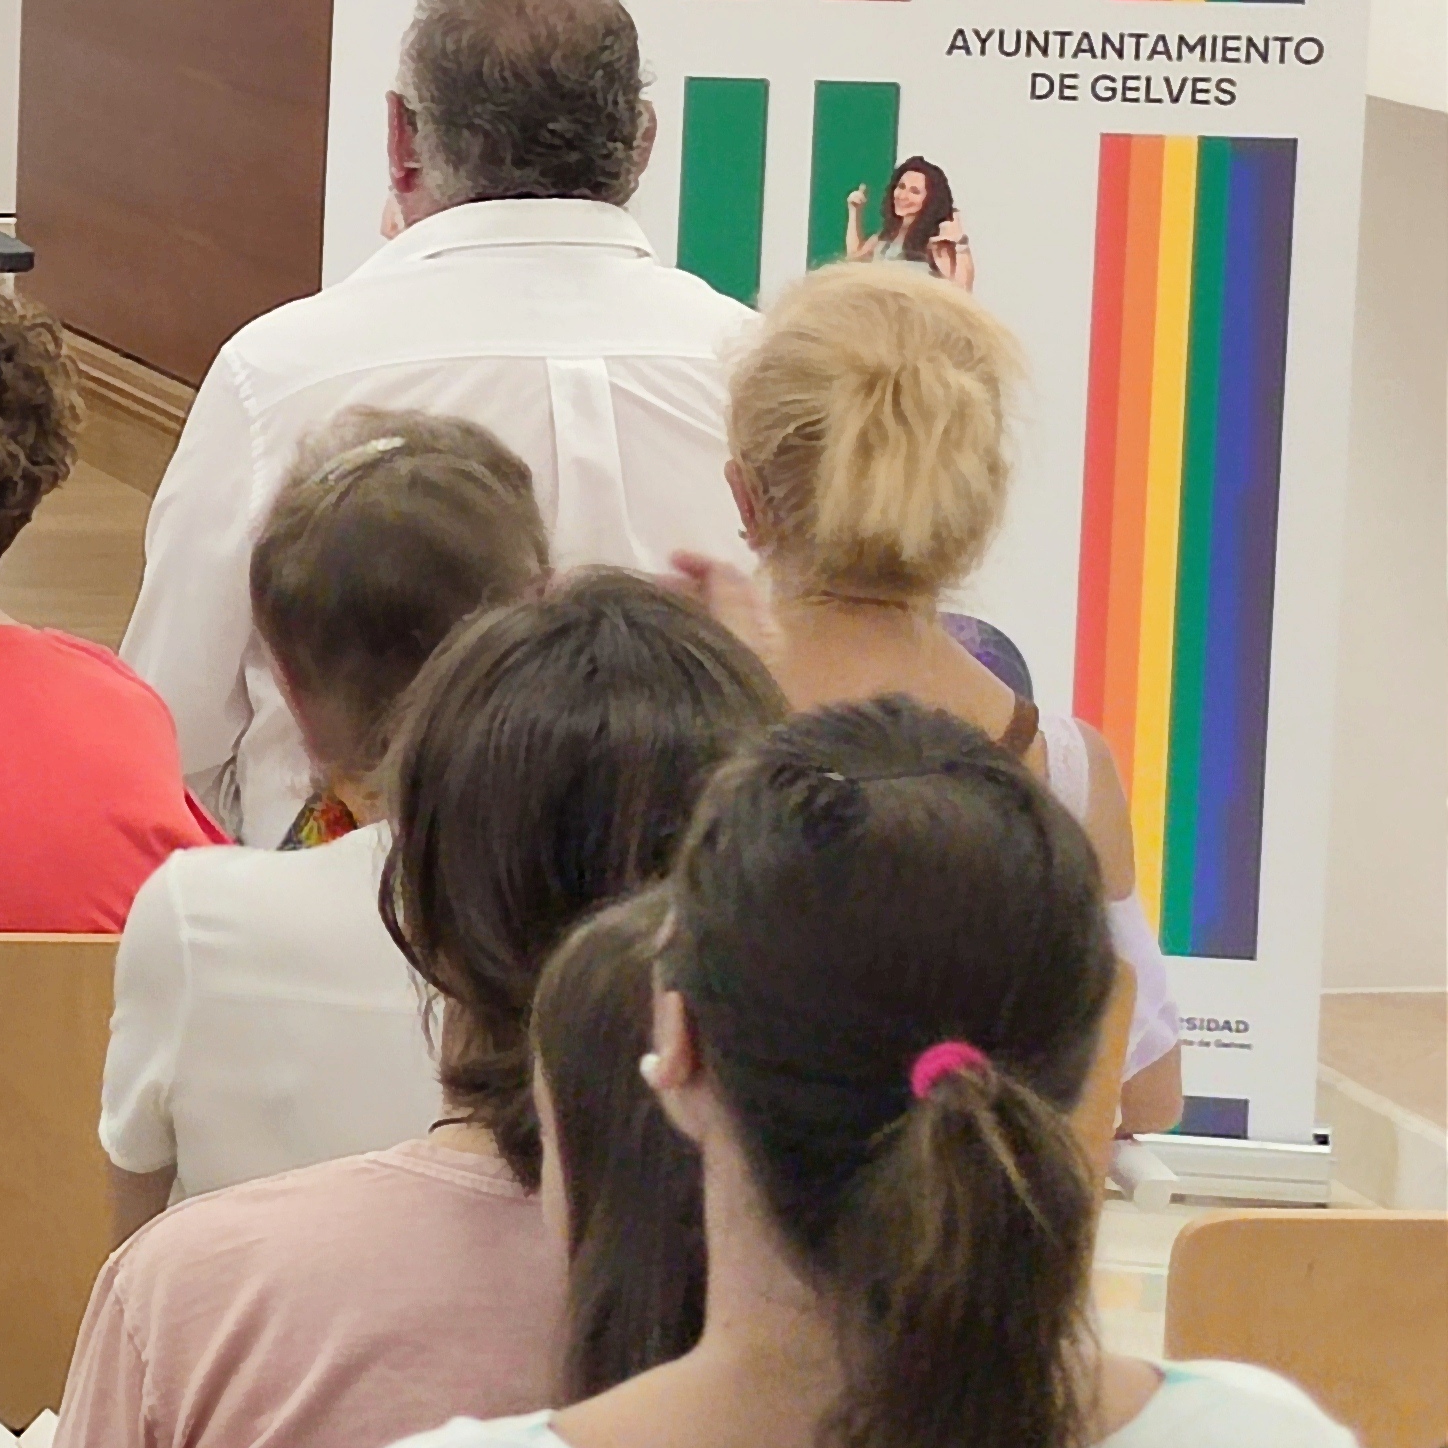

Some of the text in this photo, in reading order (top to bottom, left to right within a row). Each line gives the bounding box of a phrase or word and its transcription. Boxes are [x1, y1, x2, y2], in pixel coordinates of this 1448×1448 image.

[944, 27, 1326, 66] AYUNTANTAMIENTO
[1028, 71, 1238, 106] DE GELVES
